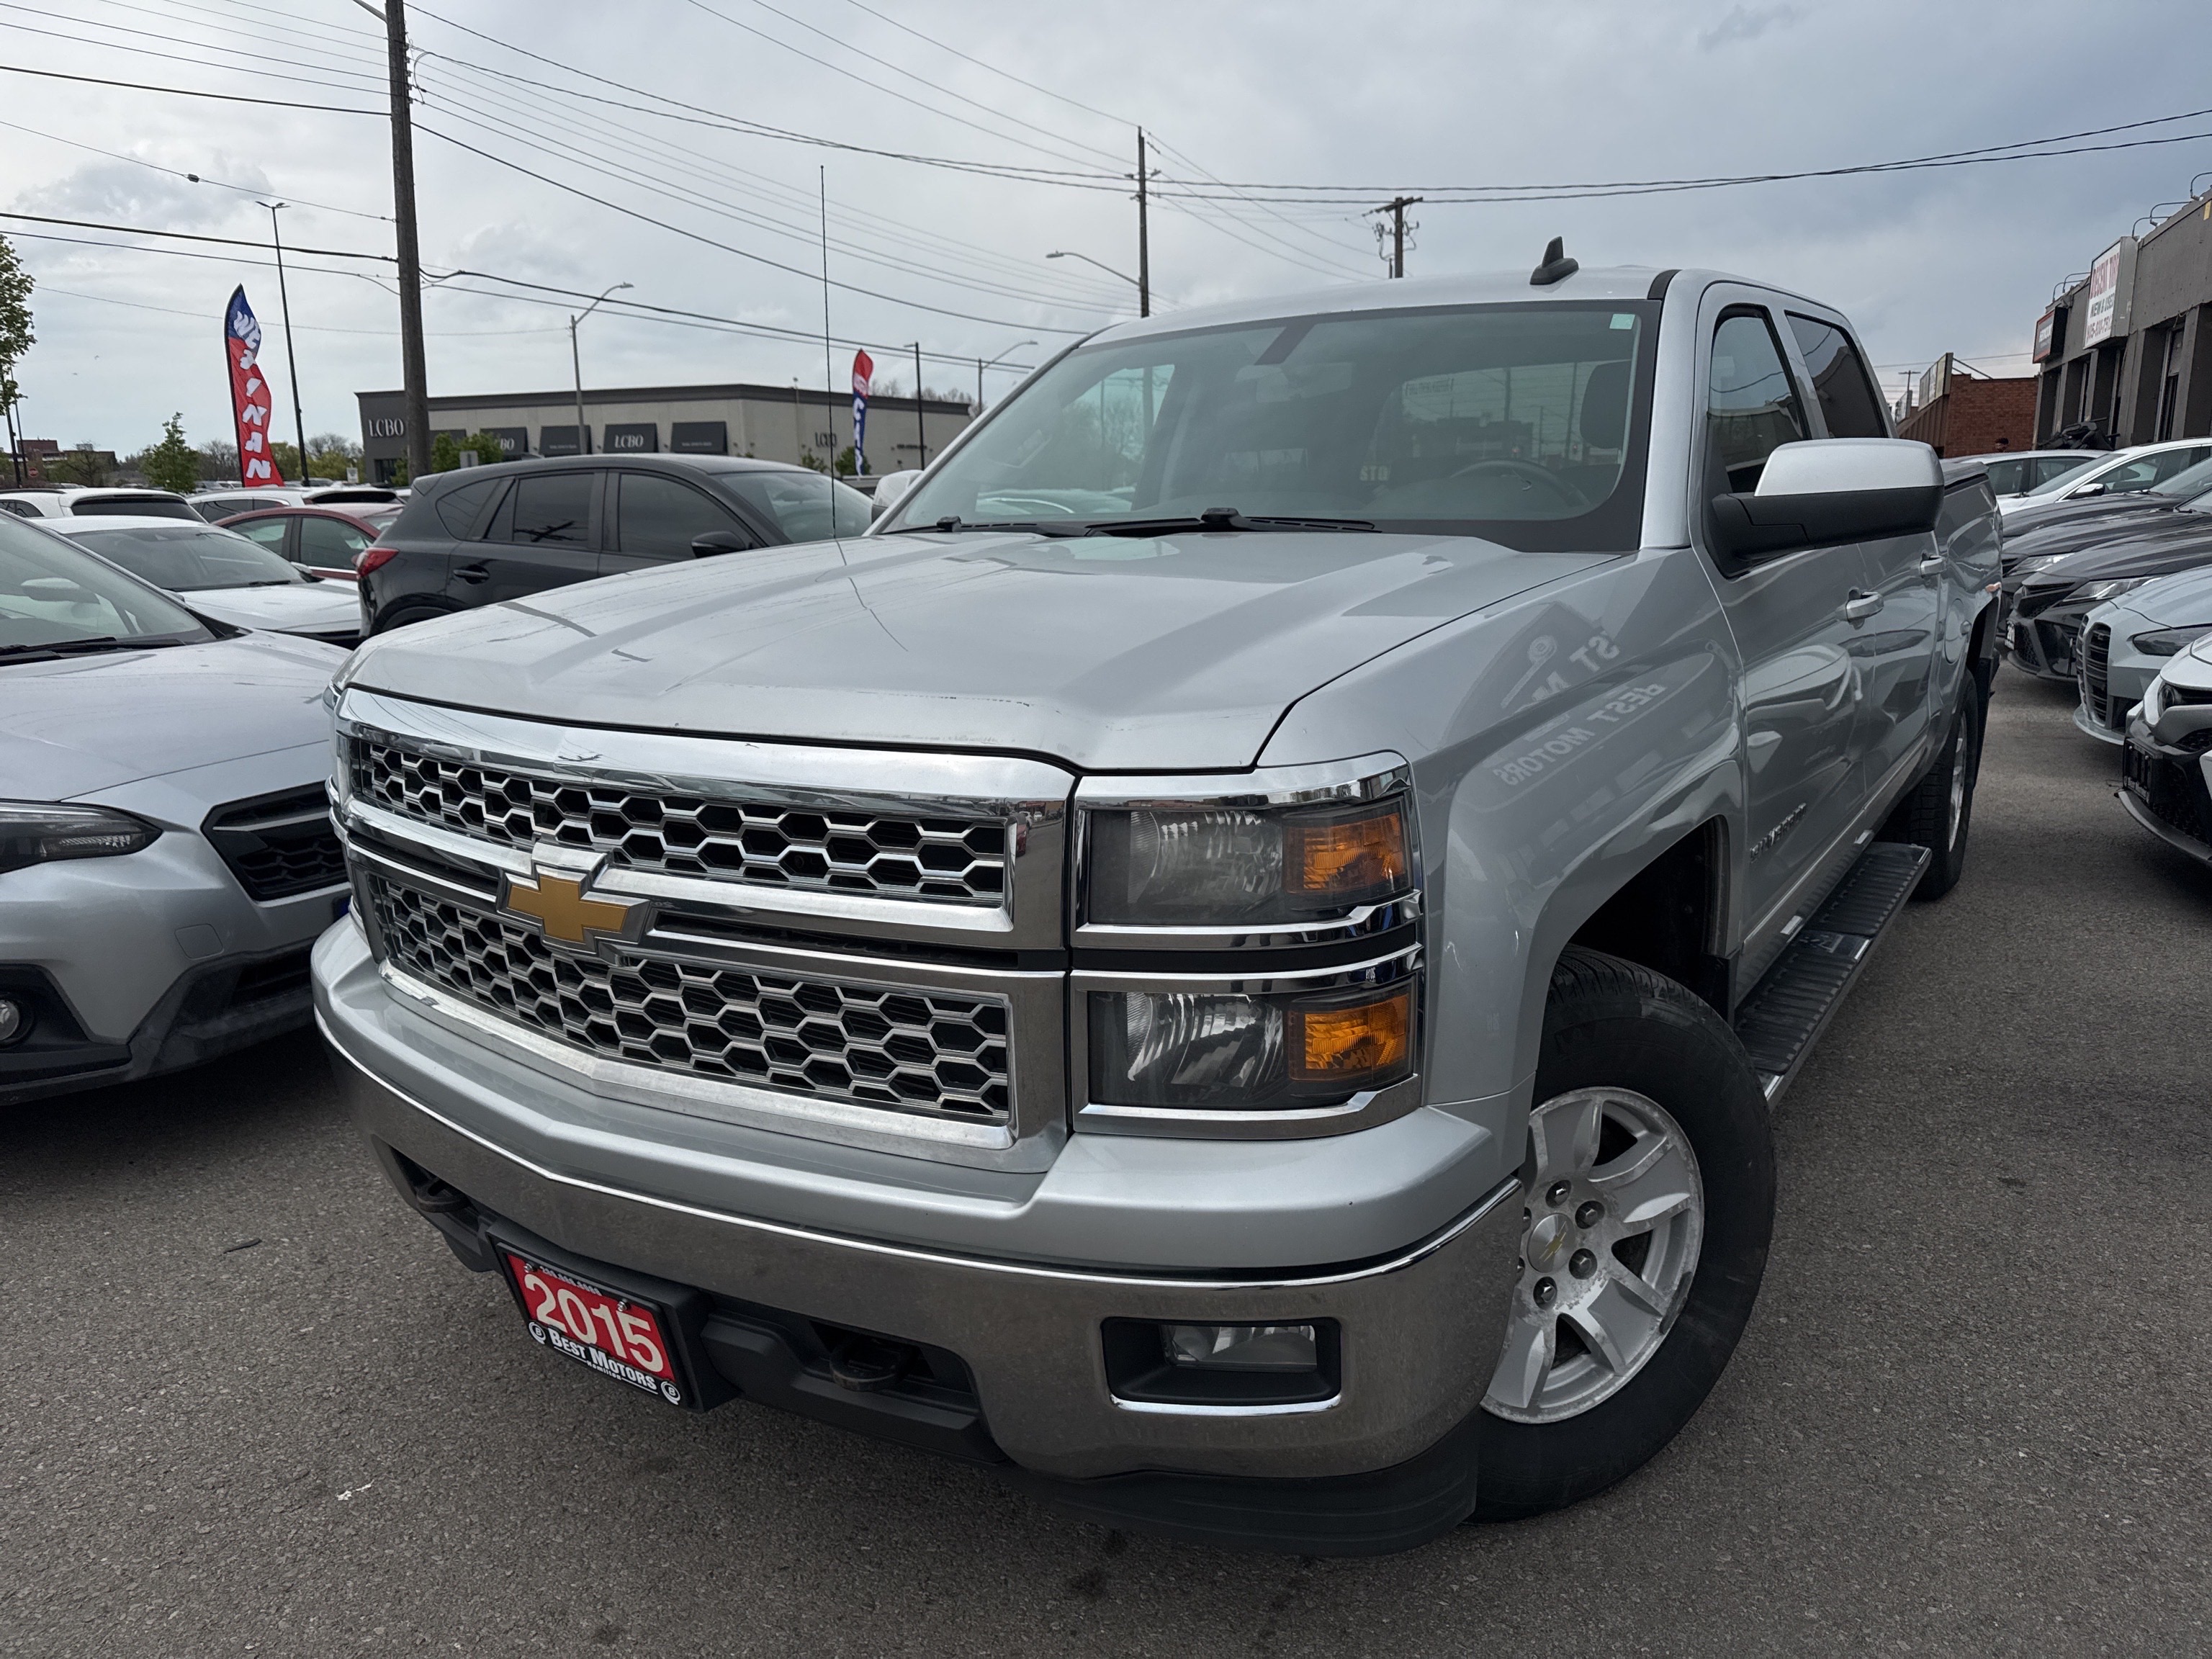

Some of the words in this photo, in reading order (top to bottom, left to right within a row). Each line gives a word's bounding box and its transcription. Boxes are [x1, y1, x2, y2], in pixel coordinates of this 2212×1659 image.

[368, 418, 405, 437] LCBO
[614, 433, 644, 449] LCBO
[524, 1274, 664, 1372] 2015
[548, 1328, 587, 1358] BEST
[588, 1345, 657, 1390] MOTORS
